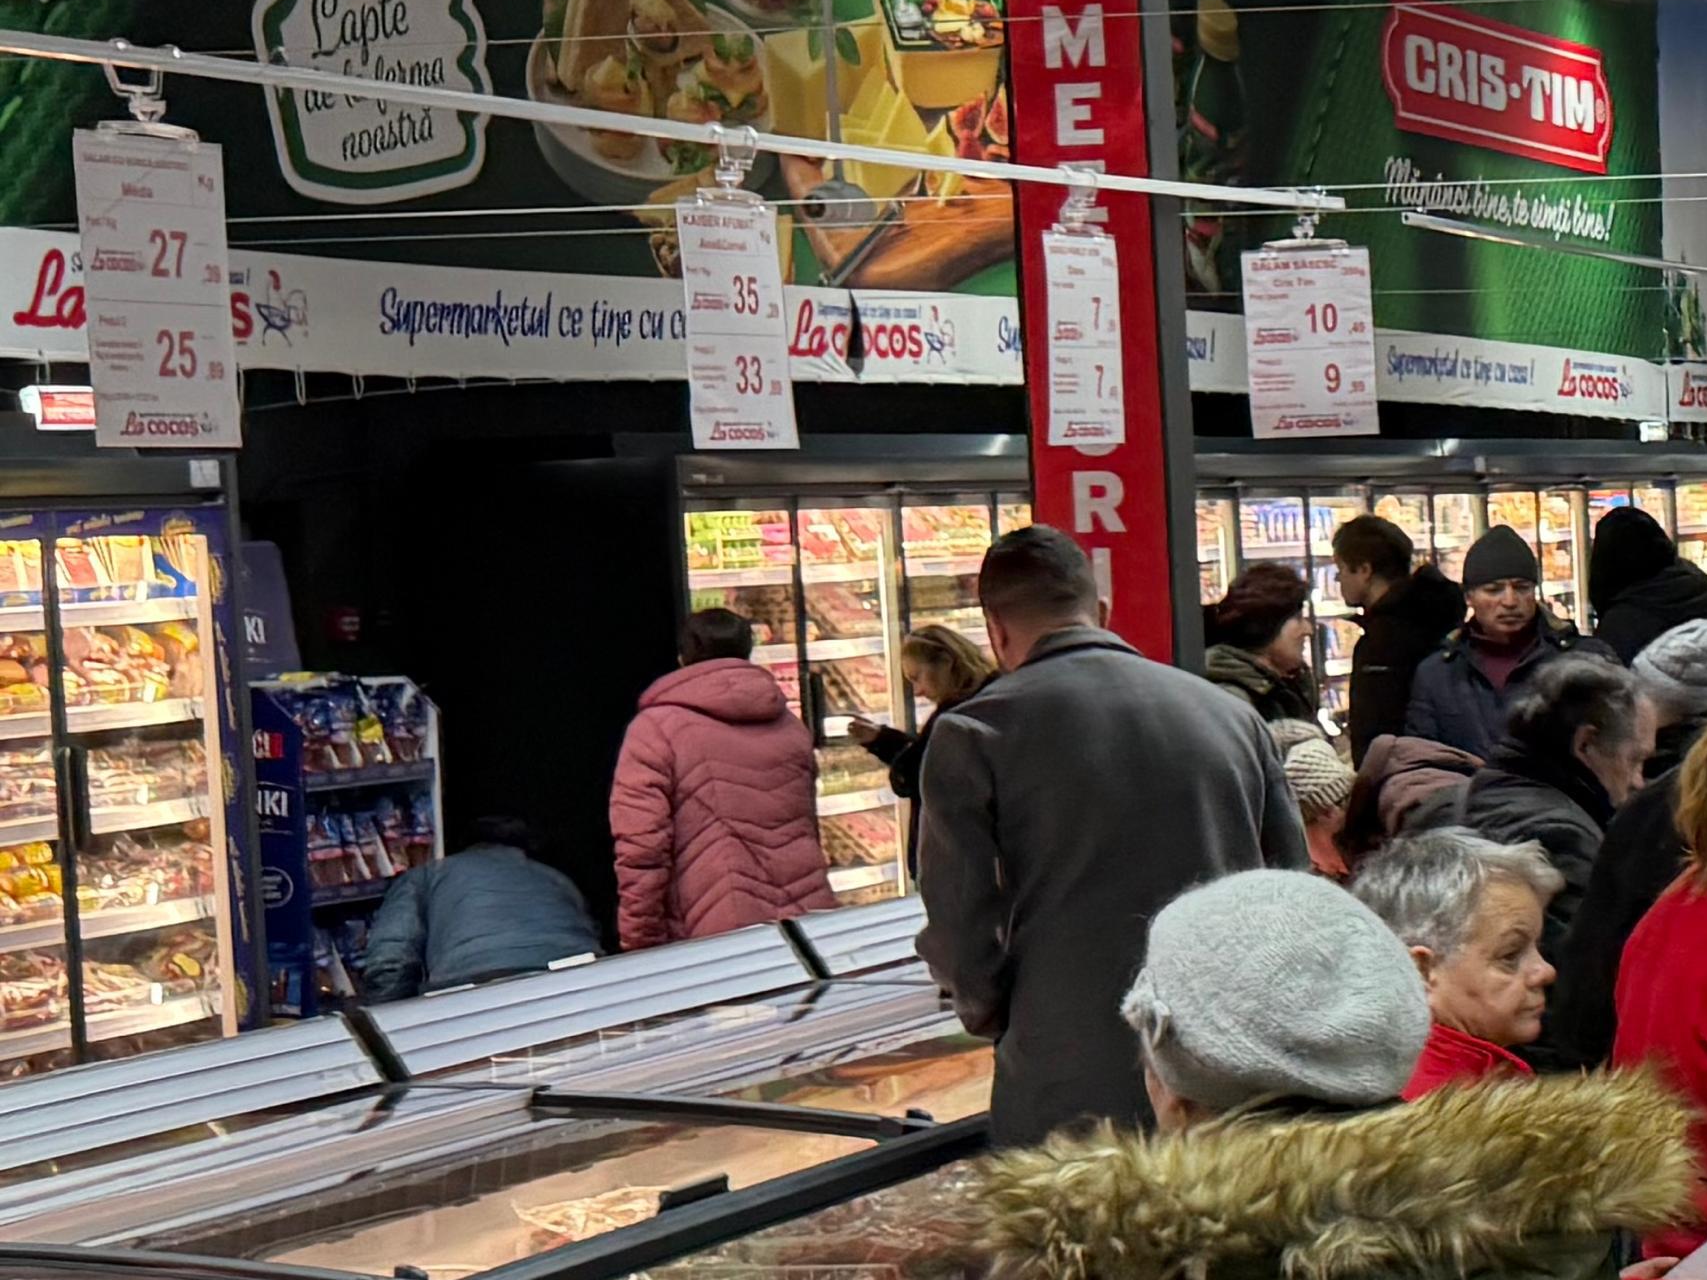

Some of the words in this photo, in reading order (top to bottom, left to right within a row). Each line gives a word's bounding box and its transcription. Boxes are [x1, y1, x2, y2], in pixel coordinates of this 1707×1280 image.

[1403, 34, 1595, 134] CRIS-TIM
[342, 108, 434, 162] noastră
[149, 229, 187, 279] 27
[13, 248, 87, 329] La
[733, 274, 760, 315] 35
[380, 286, 552, 347] Supermarketul
[558, 305, 582, 340] ce
[639, 307, 663, 340] cu
[788, 298, 829, 357] La
[1305, 302, 1338, 333] 10
[157, 329, 197, 379] 25
[735, 355, 763, 395] 33
[1324, 363, 1341, 394] 9
